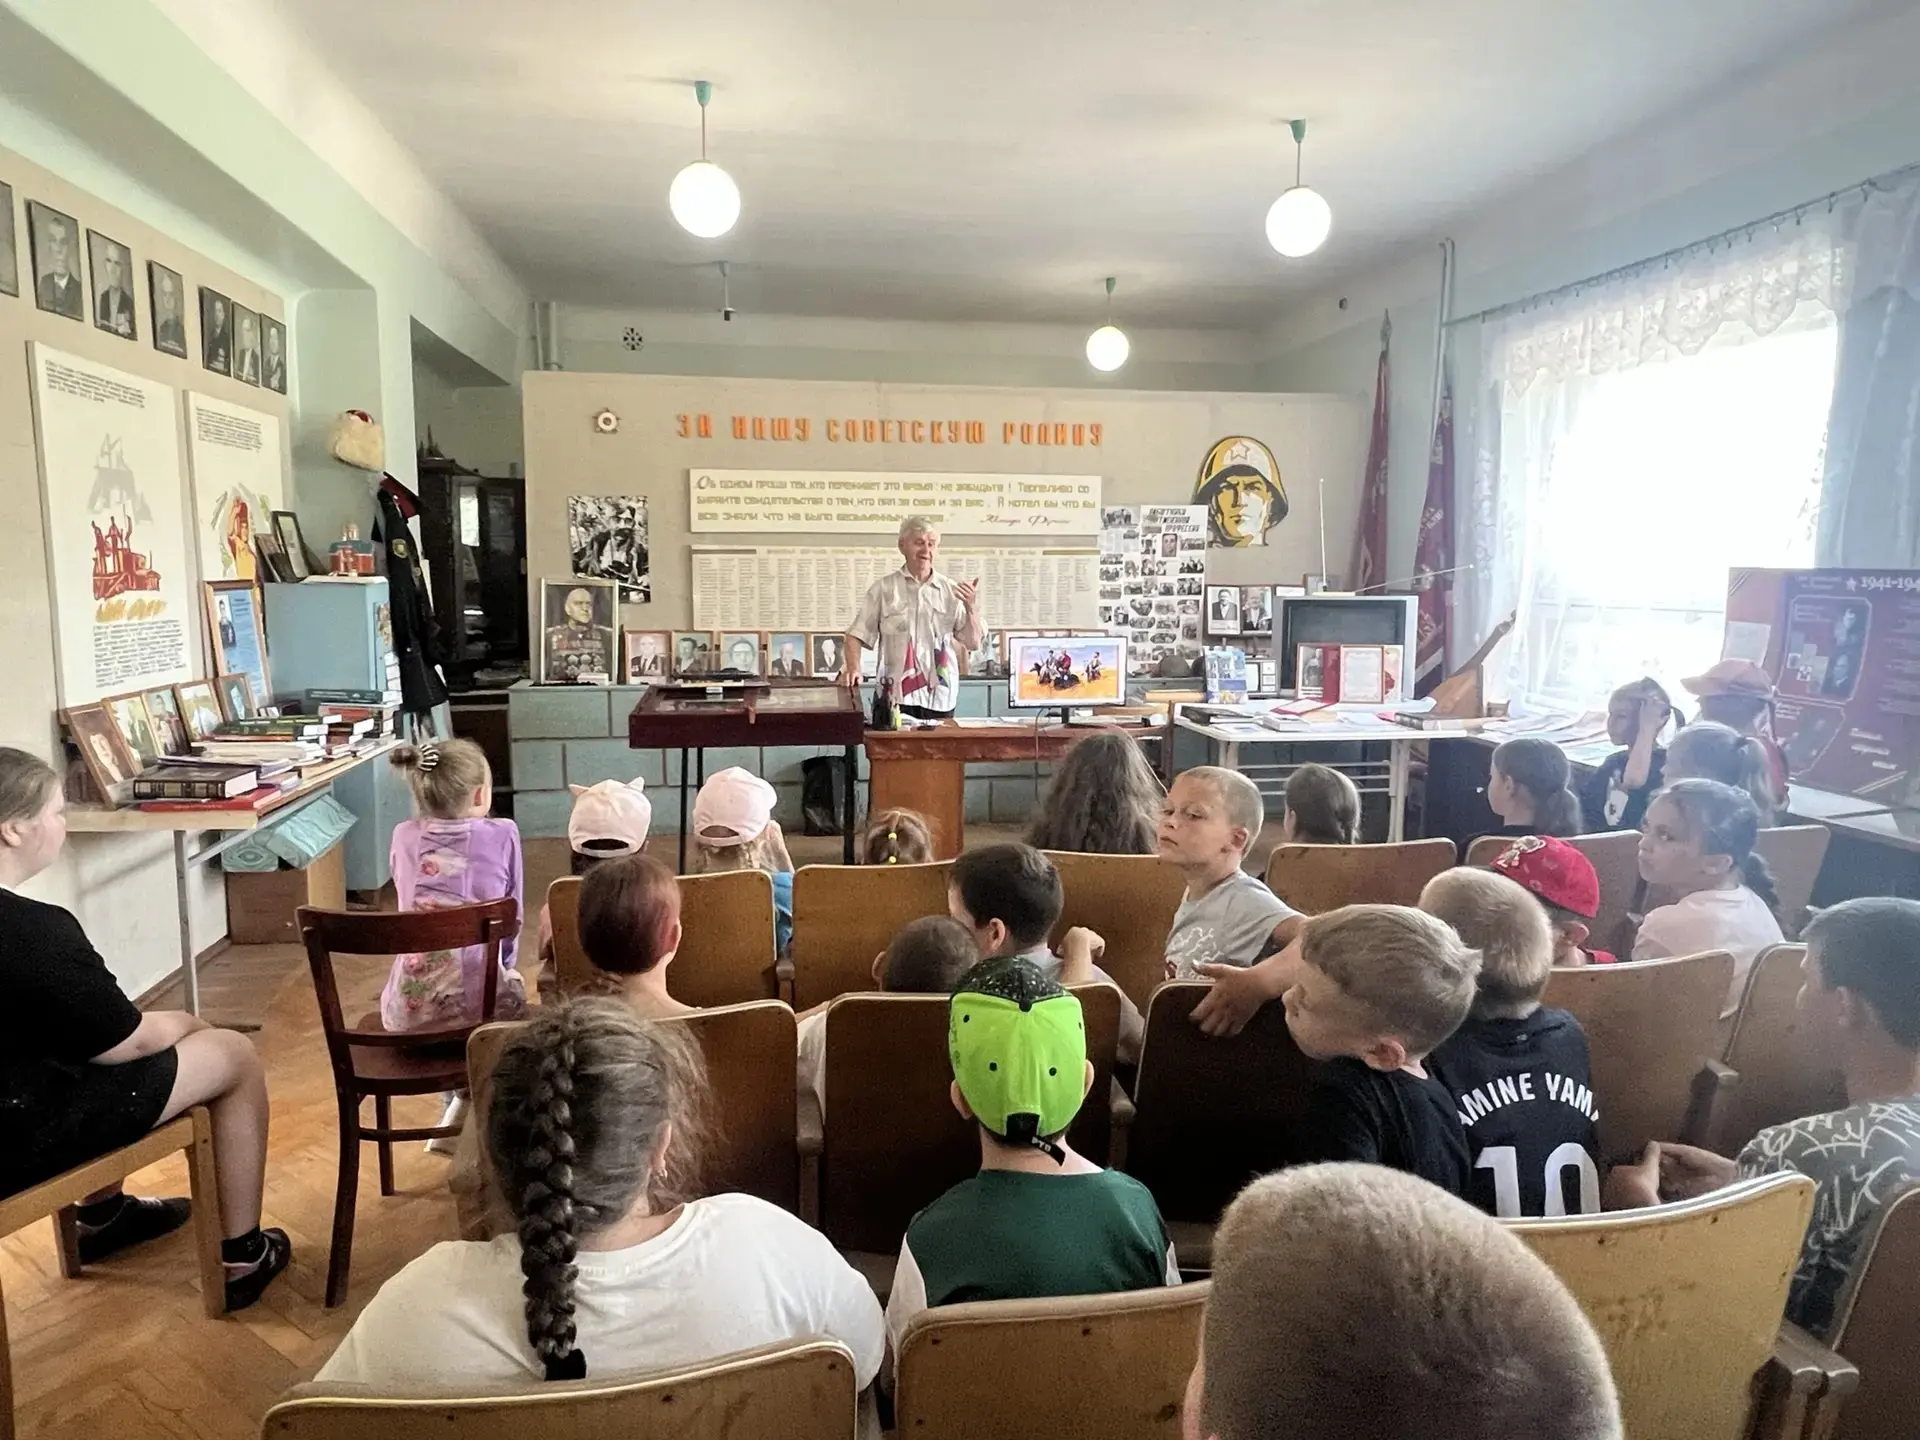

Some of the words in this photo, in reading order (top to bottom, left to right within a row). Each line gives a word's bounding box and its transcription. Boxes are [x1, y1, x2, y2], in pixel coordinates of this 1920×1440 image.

[676, 413, 712, 438] ЗА
[732, 415, 809, 441] НАШУ
[826, 418, 985, 444] СОВЕТСКУЮ
[1003, 422, 1103, 446] РОДИНУ
[1545, 1072, 1599, 1122] YAM
[1474, 1142, 1601, 1217] 10
